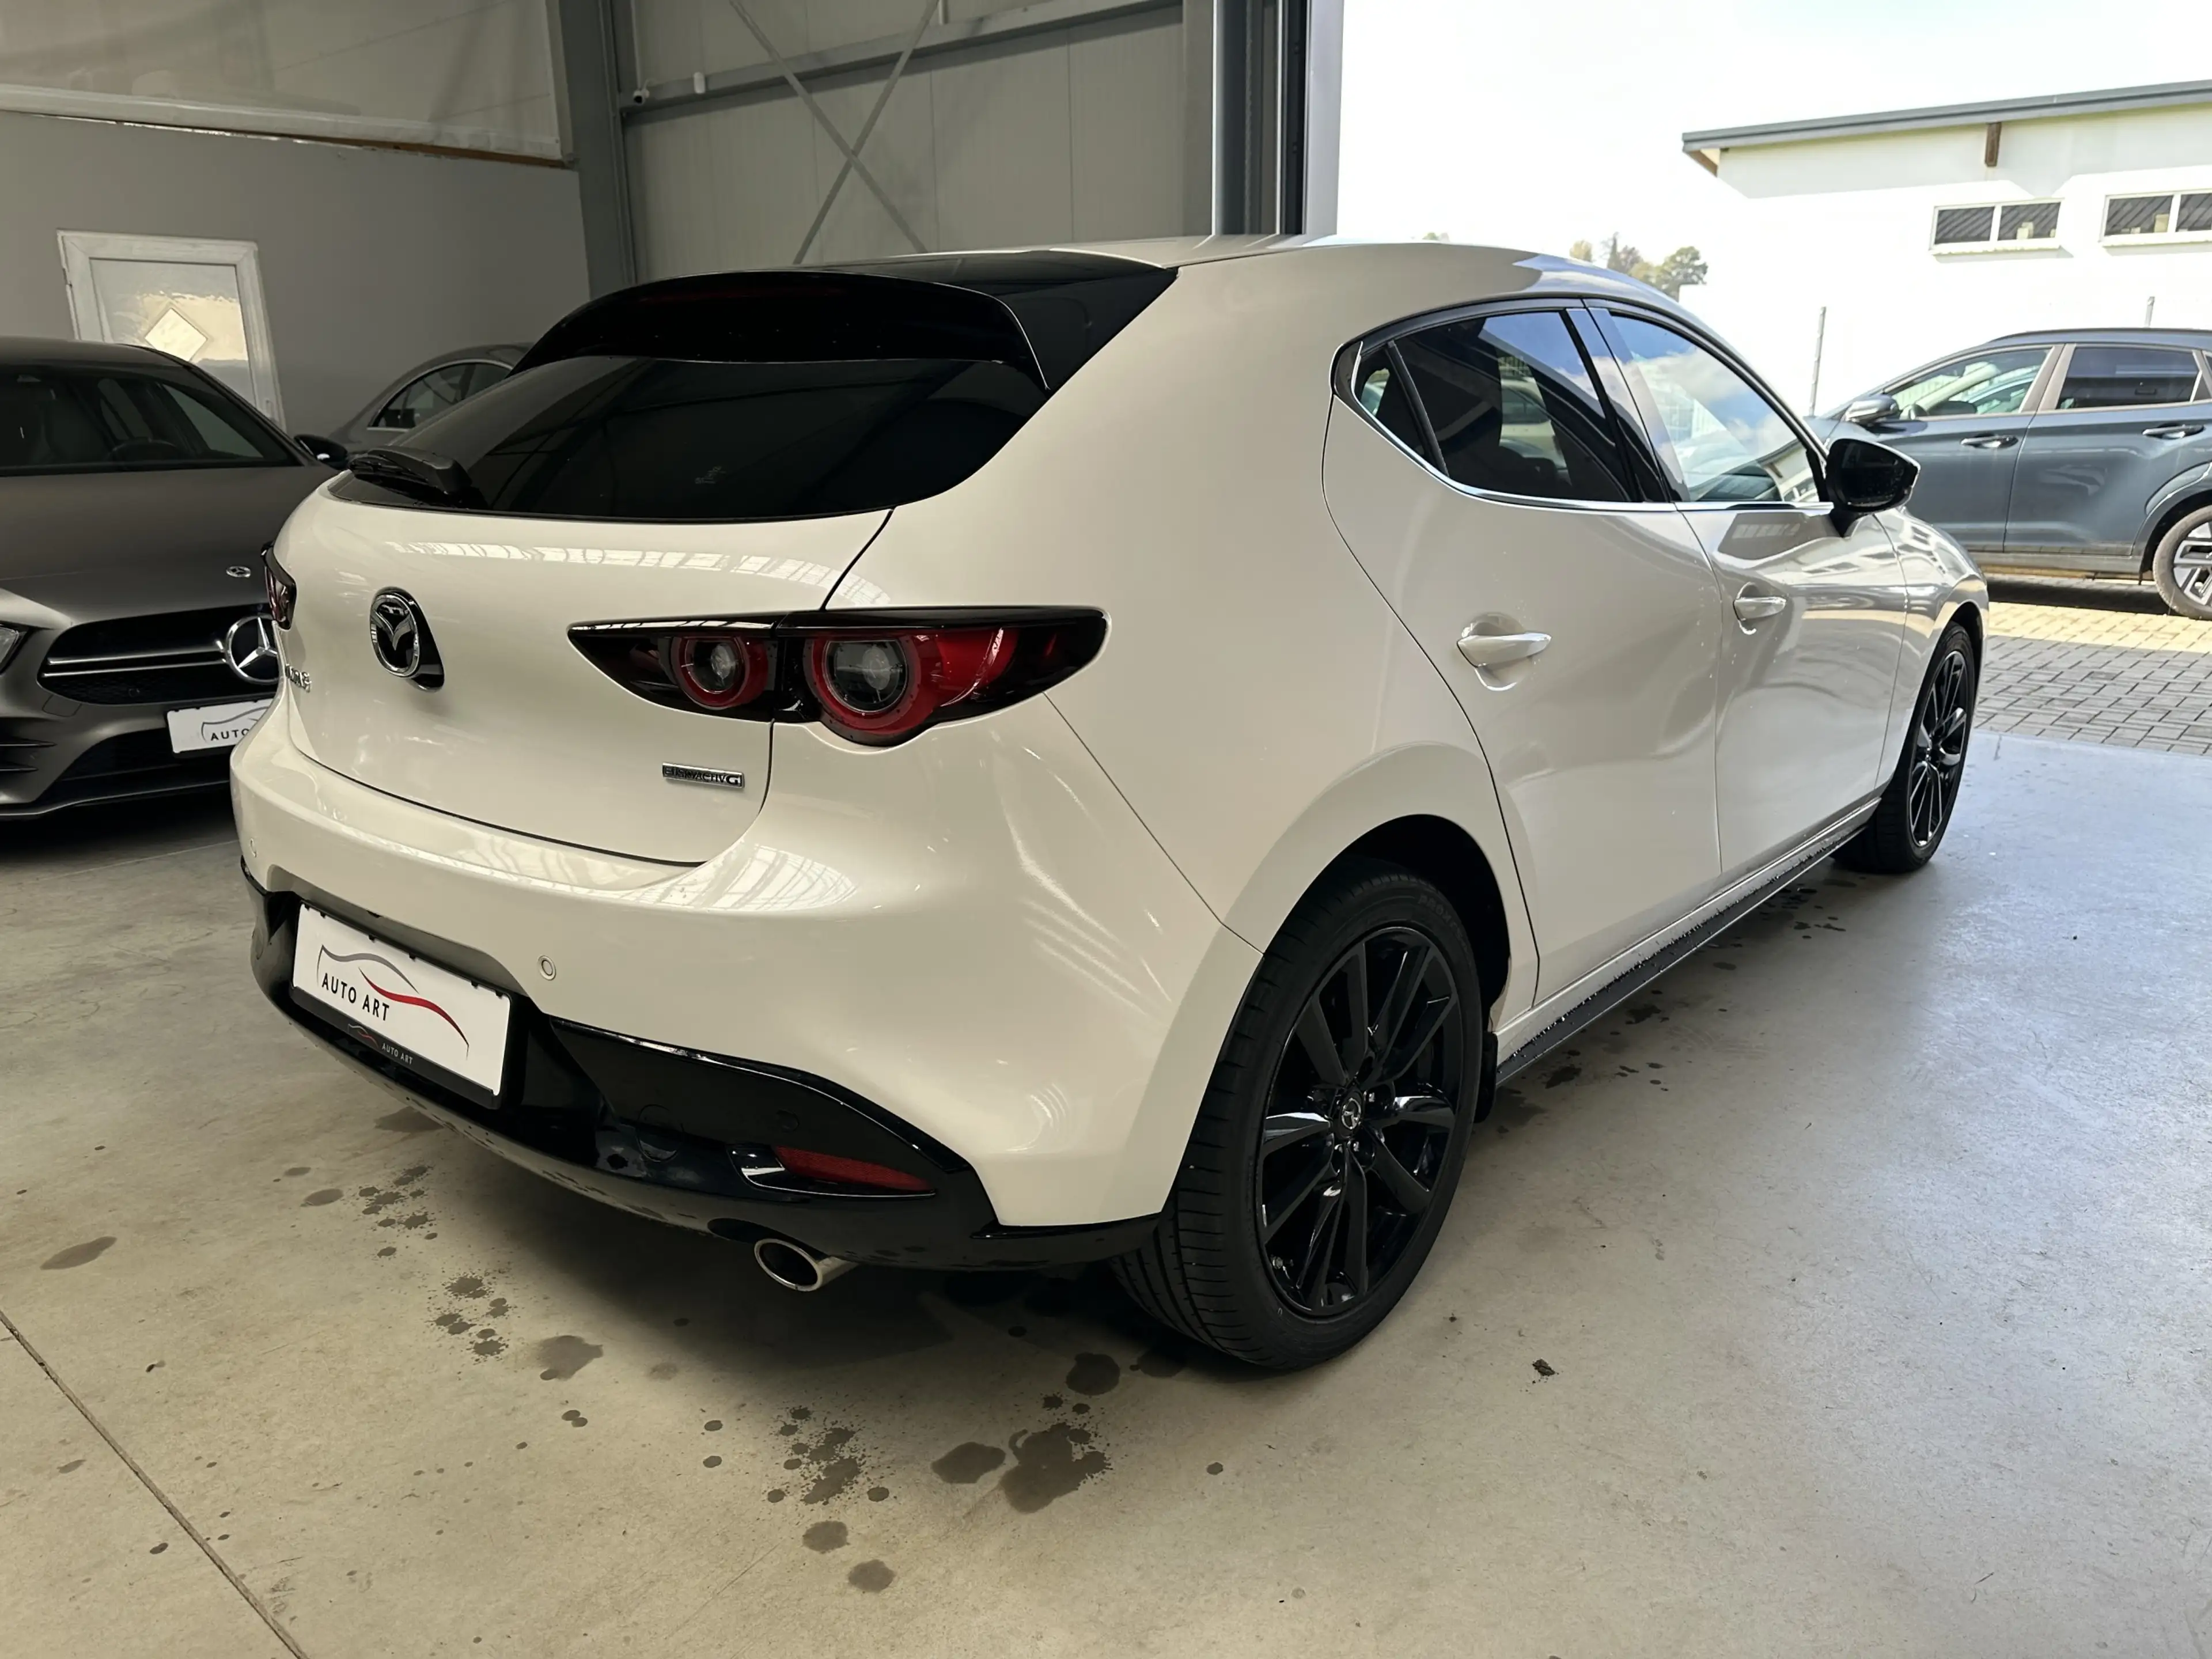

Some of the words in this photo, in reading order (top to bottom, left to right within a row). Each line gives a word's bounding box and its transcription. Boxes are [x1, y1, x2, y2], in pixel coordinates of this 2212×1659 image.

[211, 728, 249, 741] AUTO
[321, 973, 357, 1003] AUTO
[362, 994, 389, 1021] ART
[381, 1043, 399, 1057] AUTO
[400, 1052, 413, 1065] ART
